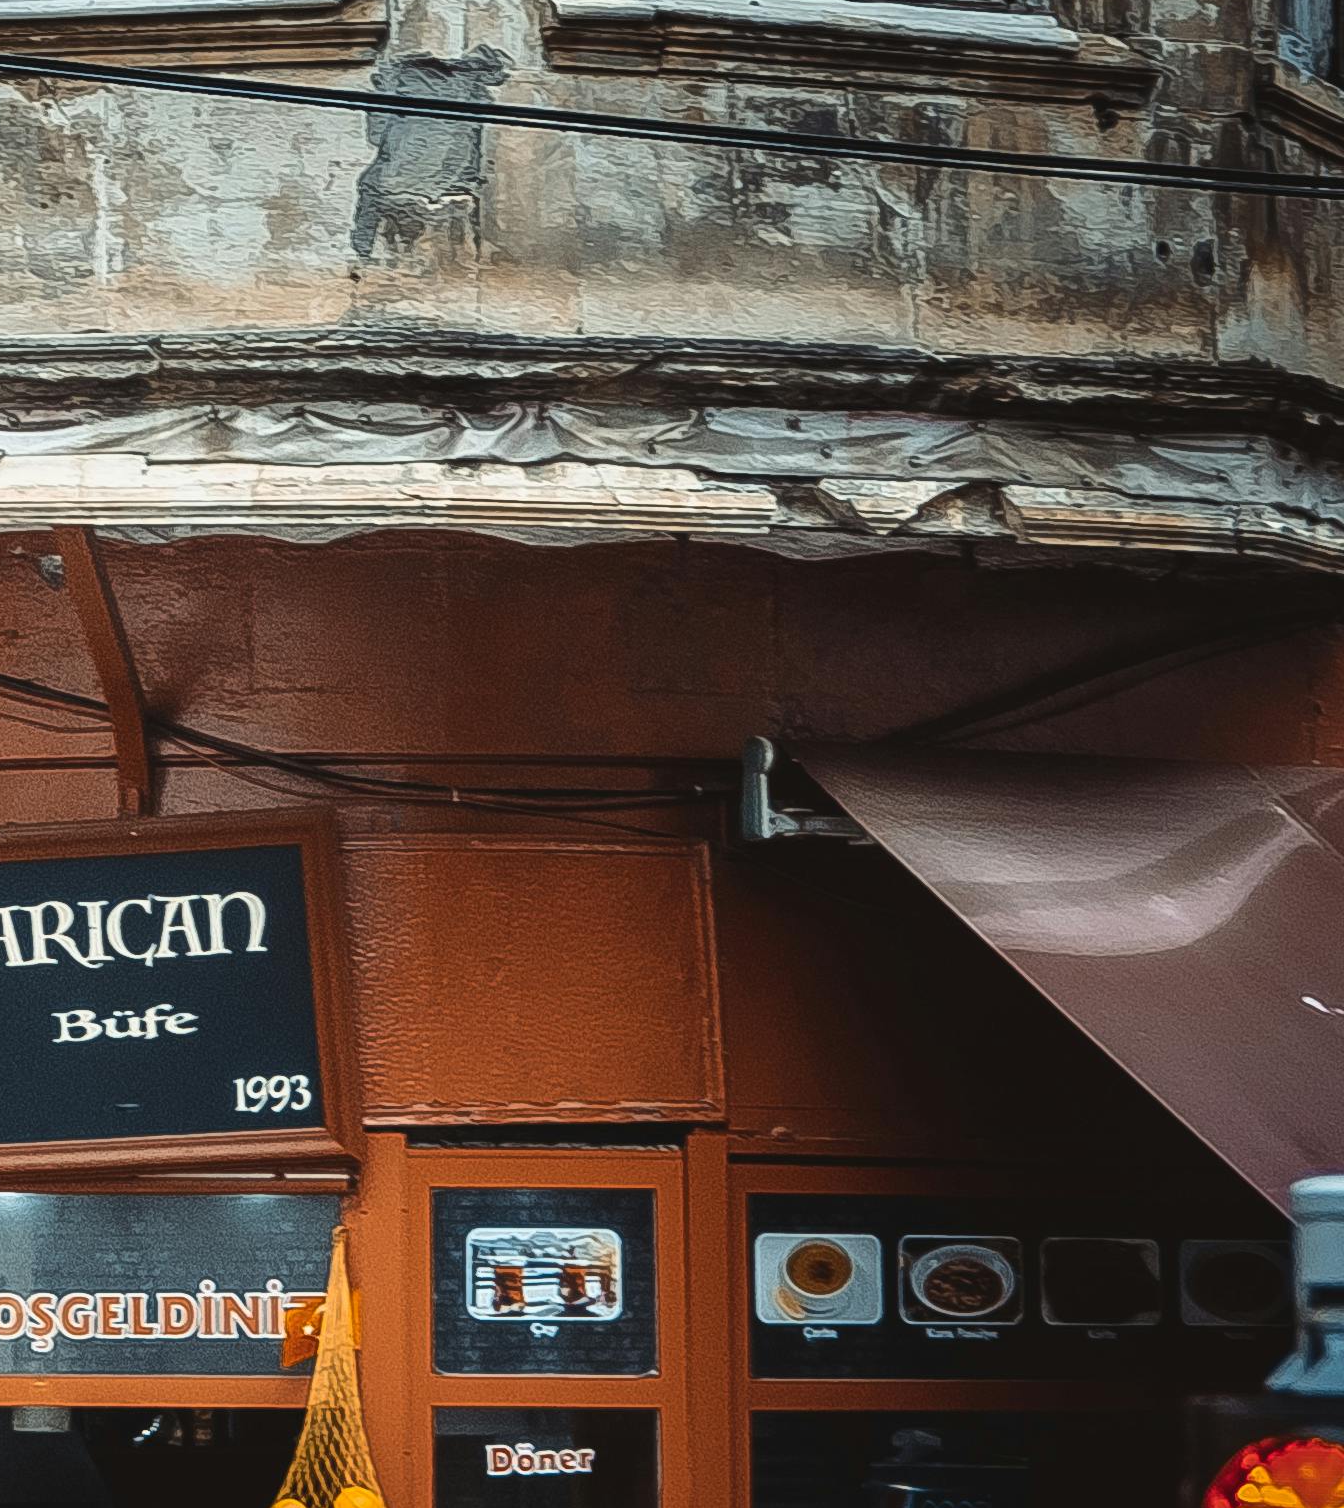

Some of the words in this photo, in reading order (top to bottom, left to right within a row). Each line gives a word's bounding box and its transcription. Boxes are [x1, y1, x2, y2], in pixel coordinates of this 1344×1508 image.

[51, 1004, 199, 1043] Büfe
[232, 1074, 313, 1113] 1993
[485, 1444, 595, 1476] Döner
